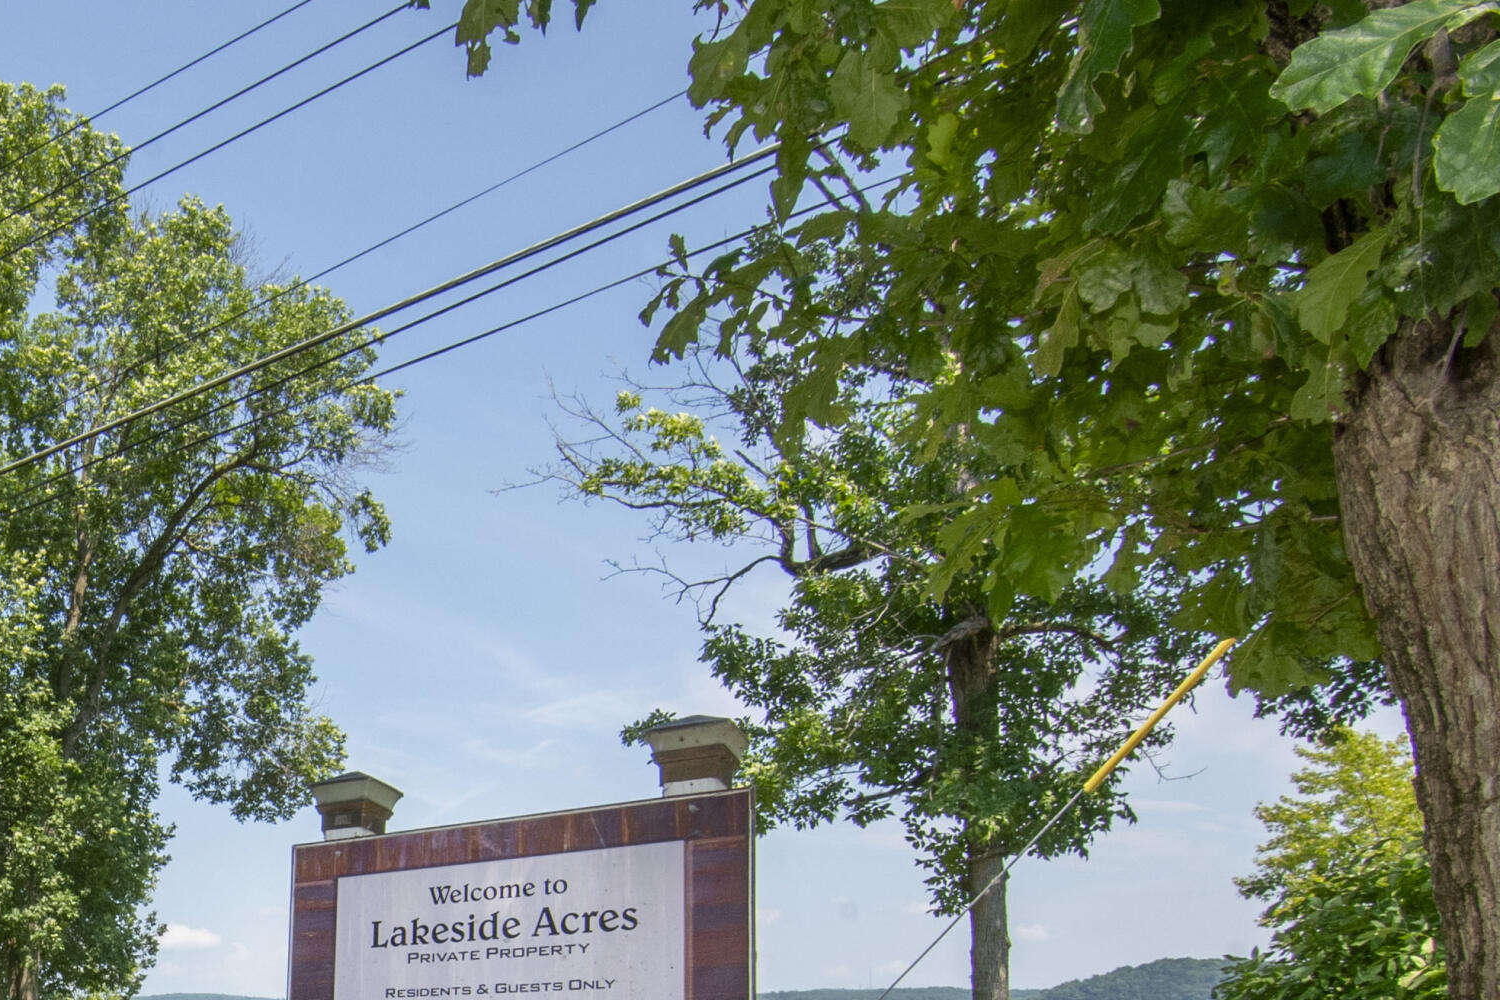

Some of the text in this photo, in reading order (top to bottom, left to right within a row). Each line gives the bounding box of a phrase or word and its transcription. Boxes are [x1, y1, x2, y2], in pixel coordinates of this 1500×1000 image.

[429, 879, 567, 905] Welcome to
[371, 907, 638, 948] Lakeside Acres
[408, 944, 589, 964] PRIVATE PROPERTY
[386, 980, 615, 998] RESIDENTS & GUESTS ONLY
